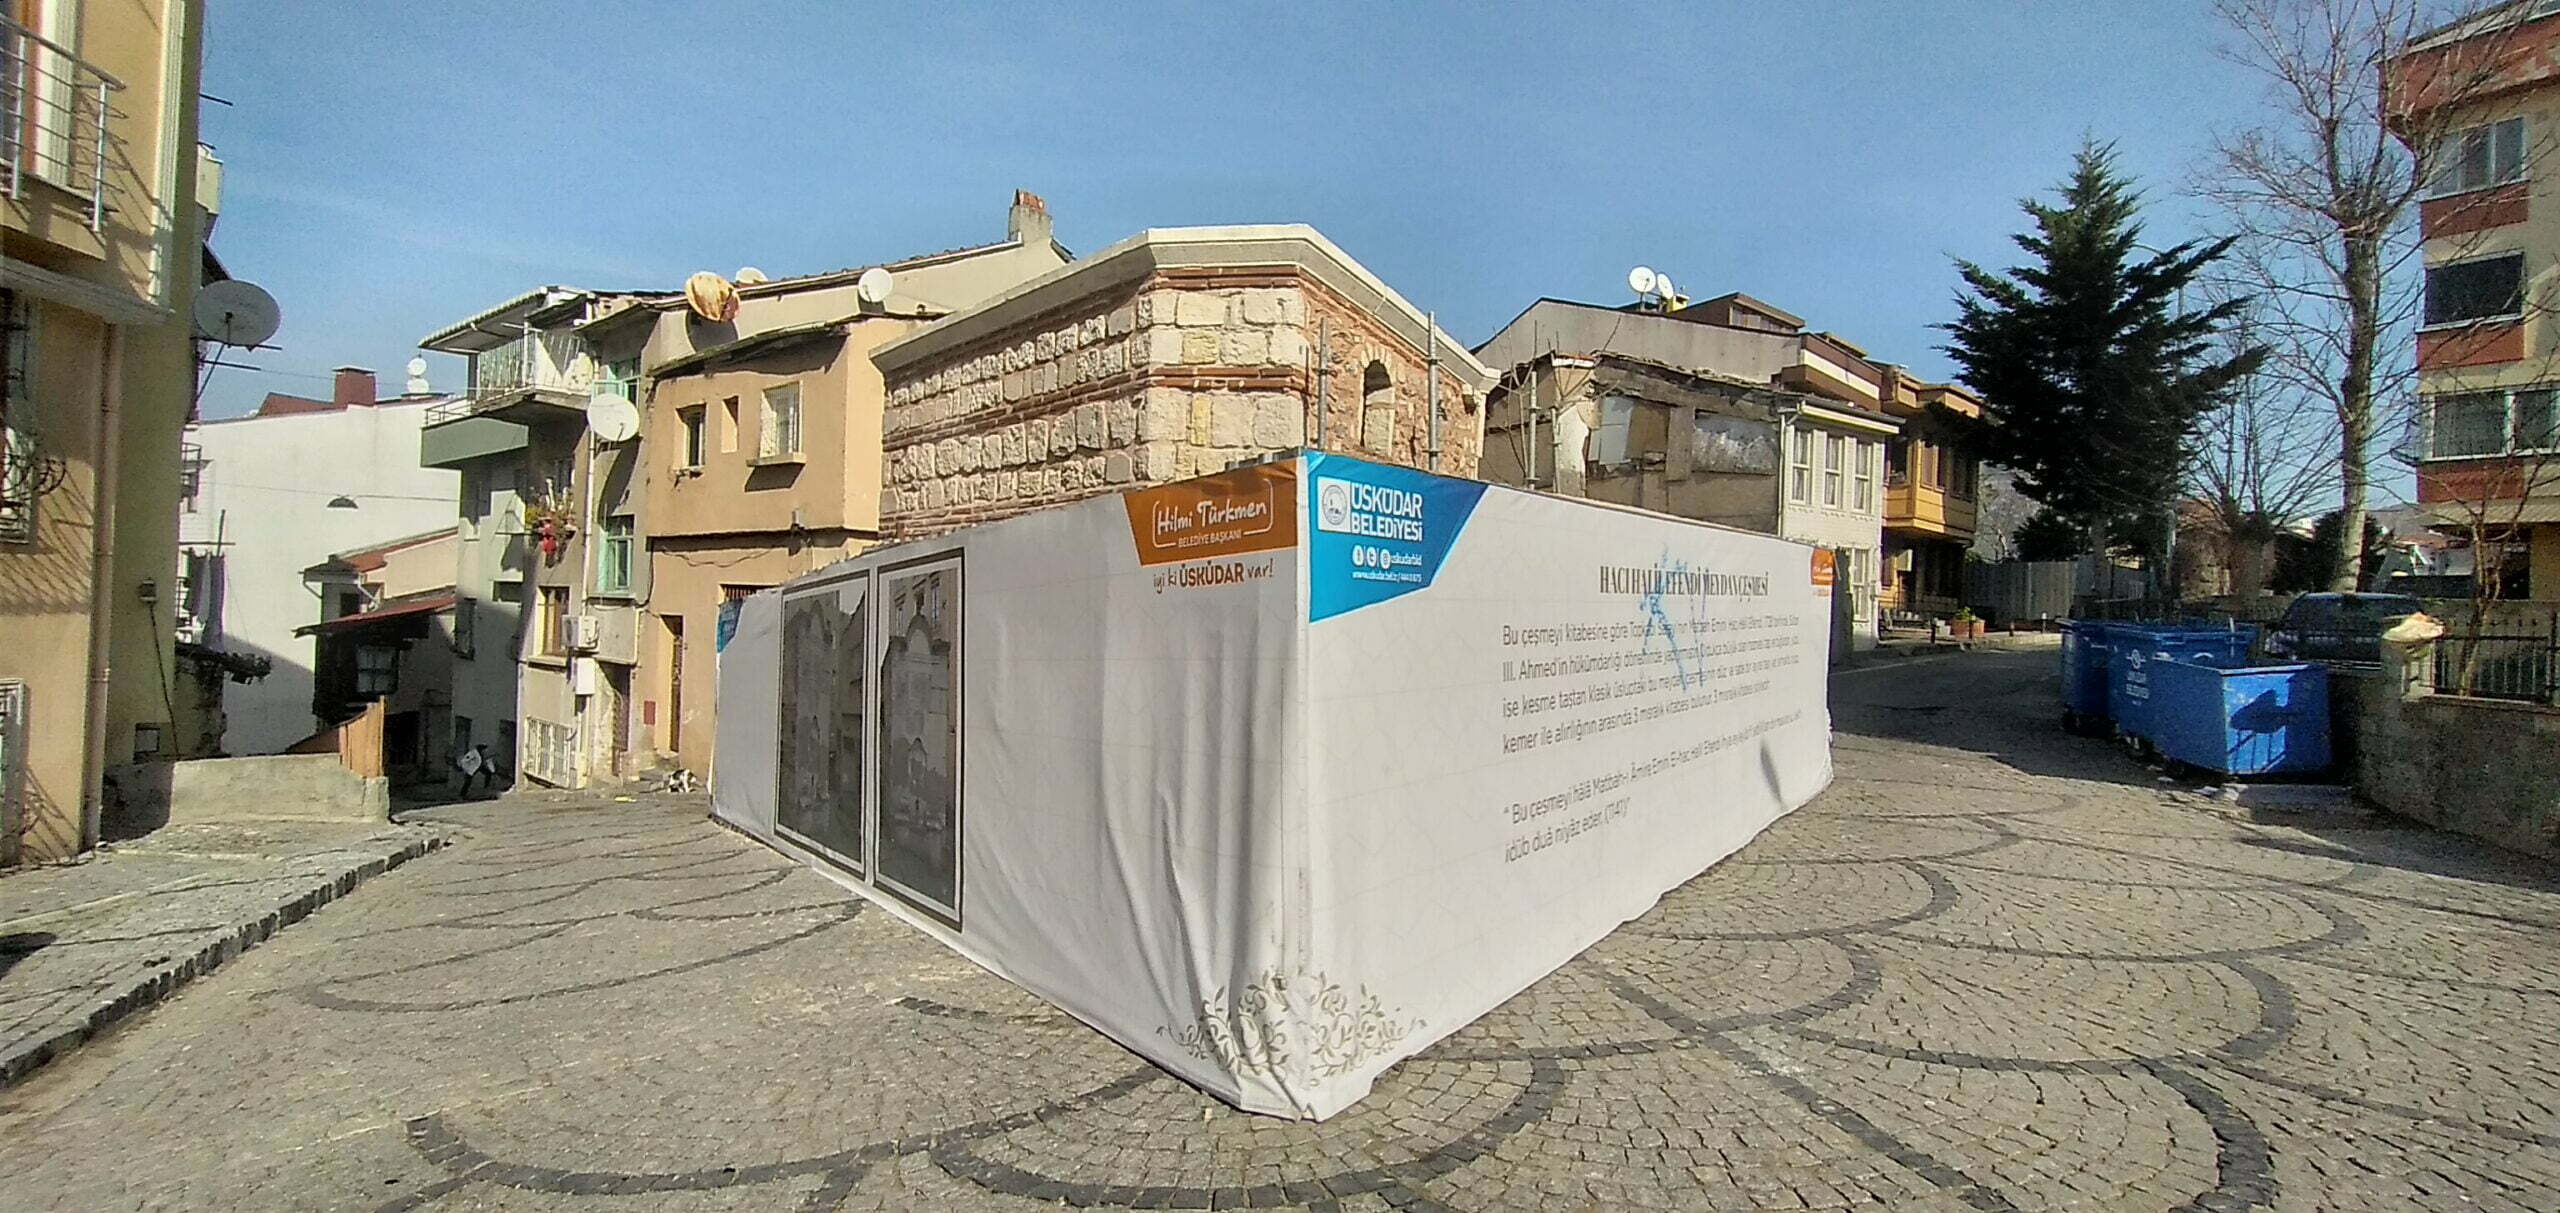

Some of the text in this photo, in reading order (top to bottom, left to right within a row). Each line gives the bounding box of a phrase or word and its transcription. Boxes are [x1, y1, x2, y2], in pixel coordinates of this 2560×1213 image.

[1351, 481, 1423, 519] ÜSKÜDAR
[1157, 498, 1268, 536] Hilmi Türkmen
[1351, 512, 1423, 542] BELEDİYESİ
[1178, 529, 1242, 548] BELEDİYE BAŞKANI
[1153, 558, 1274, 594] iyi ki ÜSKÜDAR var!
[1600, 564, 1630, 595] HACI
[1631, 563, 1663, 596] HALİL
[1503, 625, 1519, 646] Bu
[1502, 661, 1516, 682] III.
[1502, 697, 1519, 718] ise
[1522, 694, 1556, 715] kesme
[1503, 732, 1538, 754] kemer
